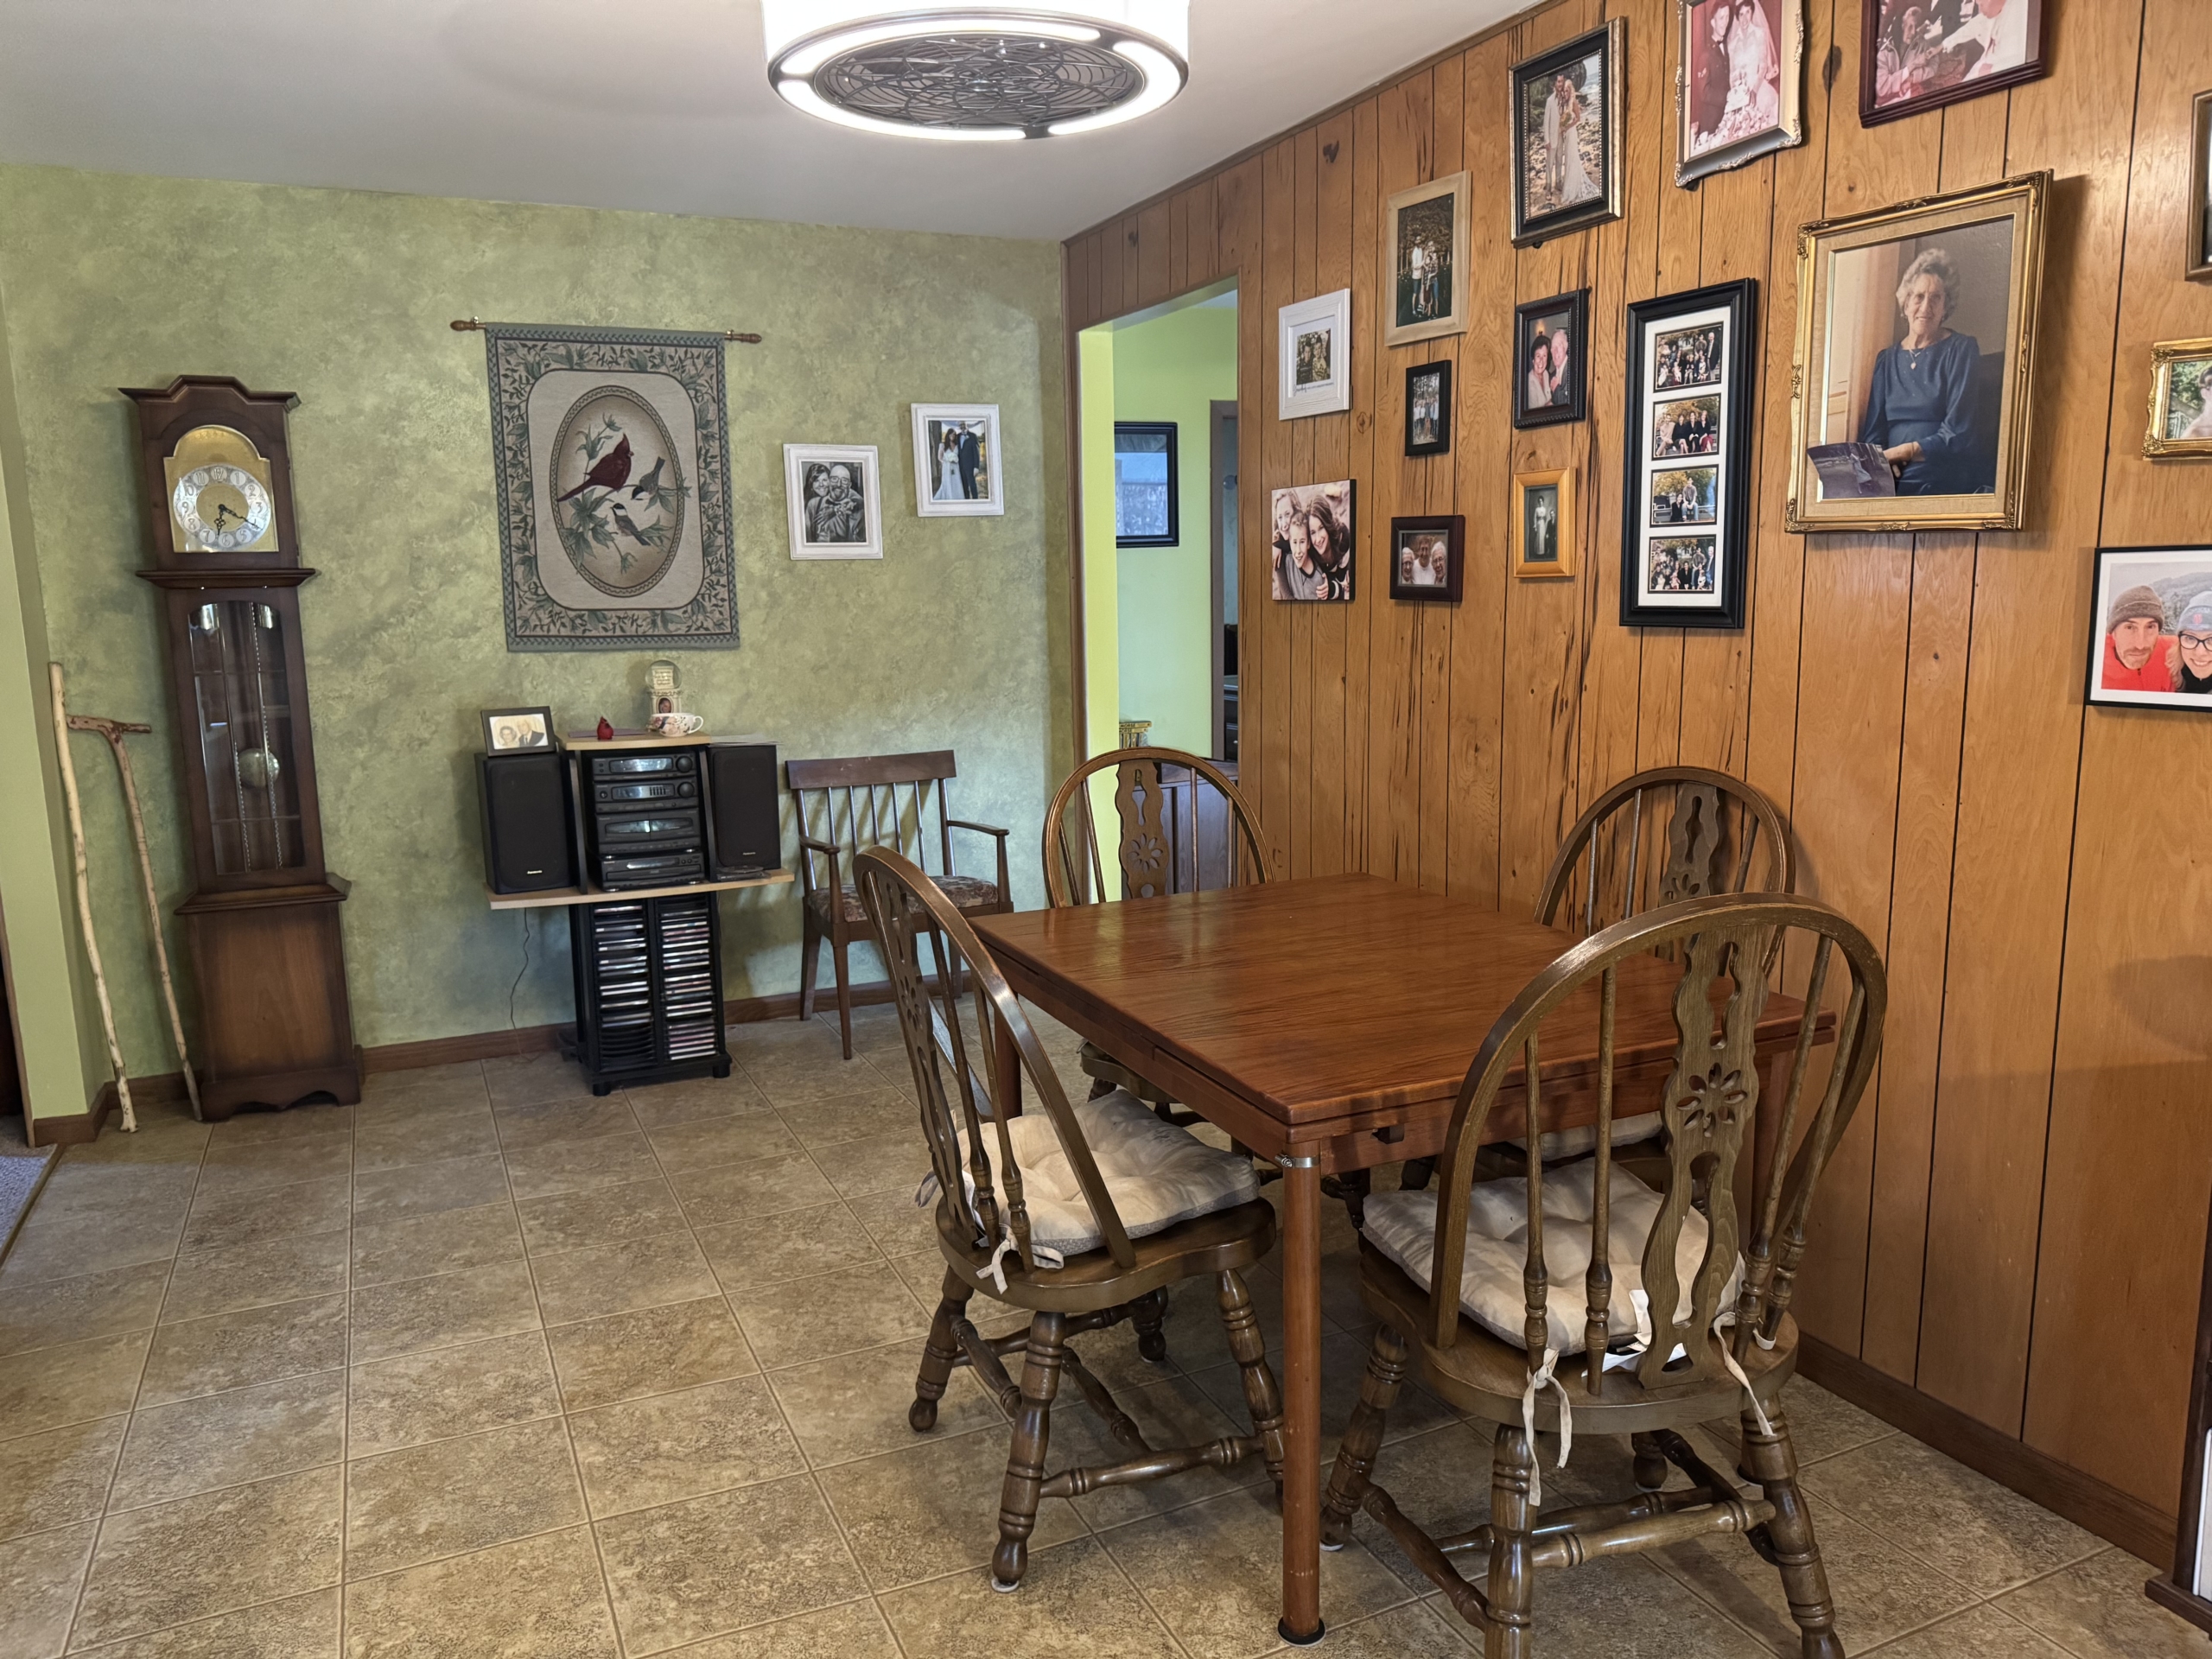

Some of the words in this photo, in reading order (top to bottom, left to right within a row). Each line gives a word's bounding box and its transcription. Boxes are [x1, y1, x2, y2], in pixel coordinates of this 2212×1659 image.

[196, 471, 206, 485] 11
[213, 467, 225, 481] 12
[248, 485, 257, 498] 2
[181, 501, 189, 513] 9
[256, 501, 264, 514] 3
[188, 518, 197, 531] 8
[203, 530, 211, 543] 7
[222, 535, 230, 547] 6
[239, 531, 247, 542] 5
